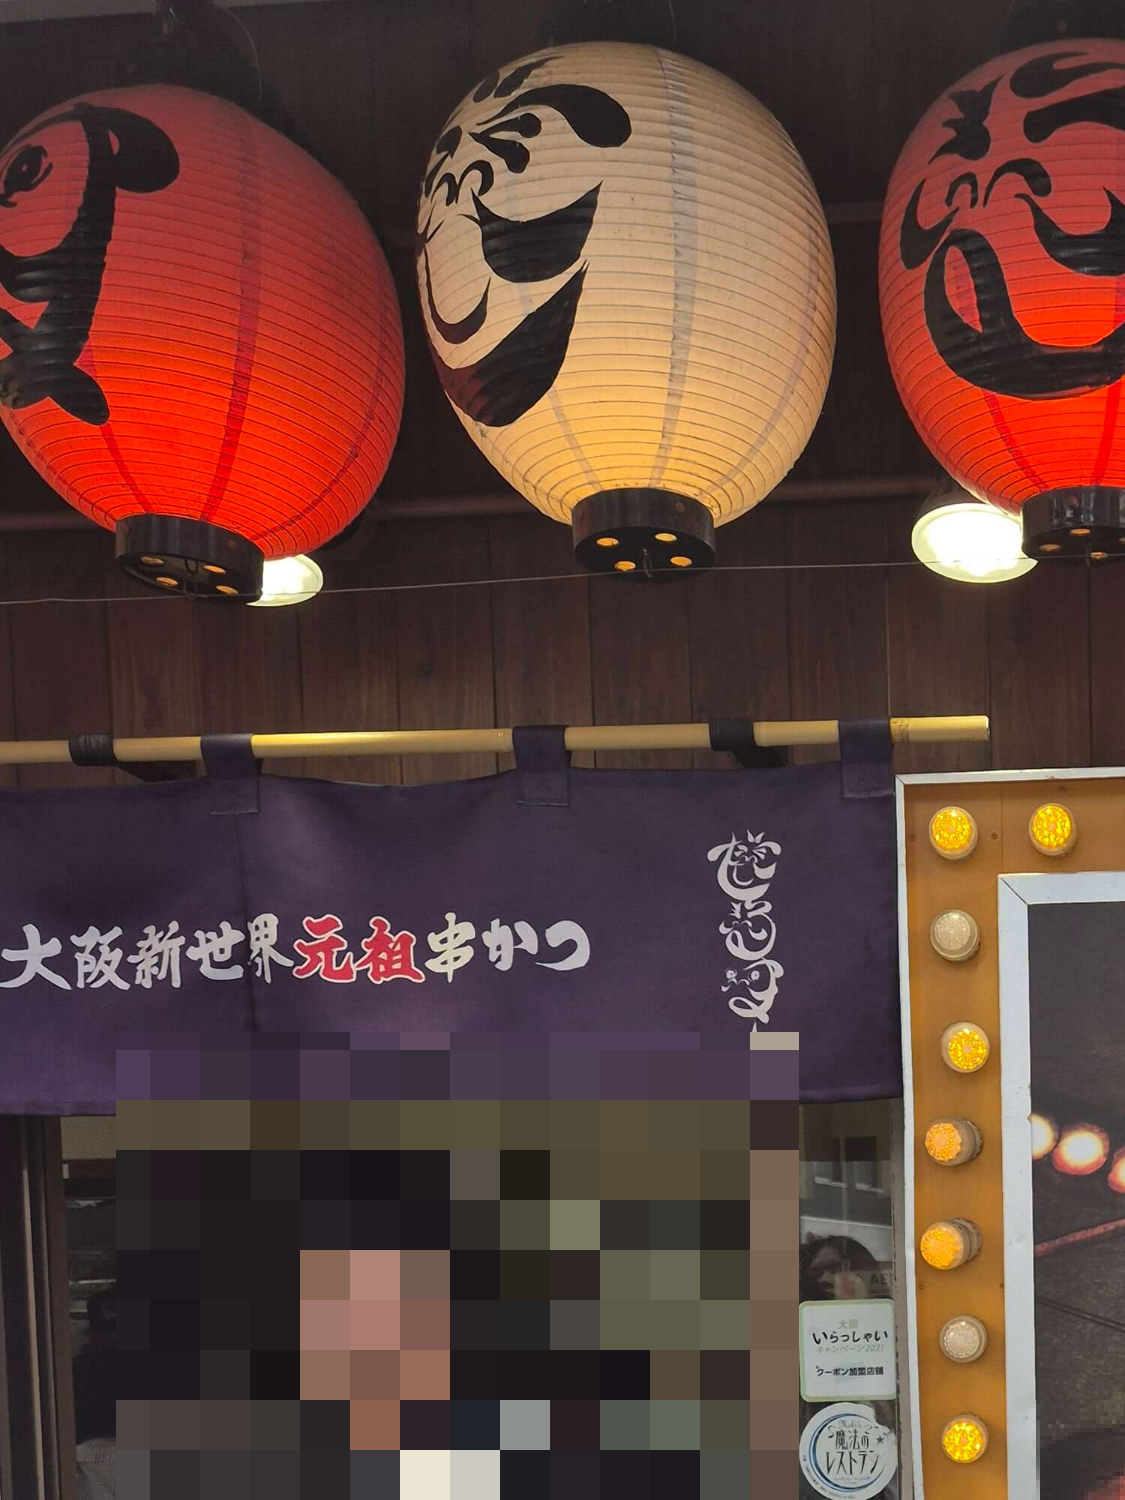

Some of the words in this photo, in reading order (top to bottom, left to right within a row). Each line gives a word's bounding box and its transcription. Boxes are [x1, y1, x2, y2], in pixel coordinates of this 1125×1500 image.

[812, 1330, 888, 1345] いらっしゃい
